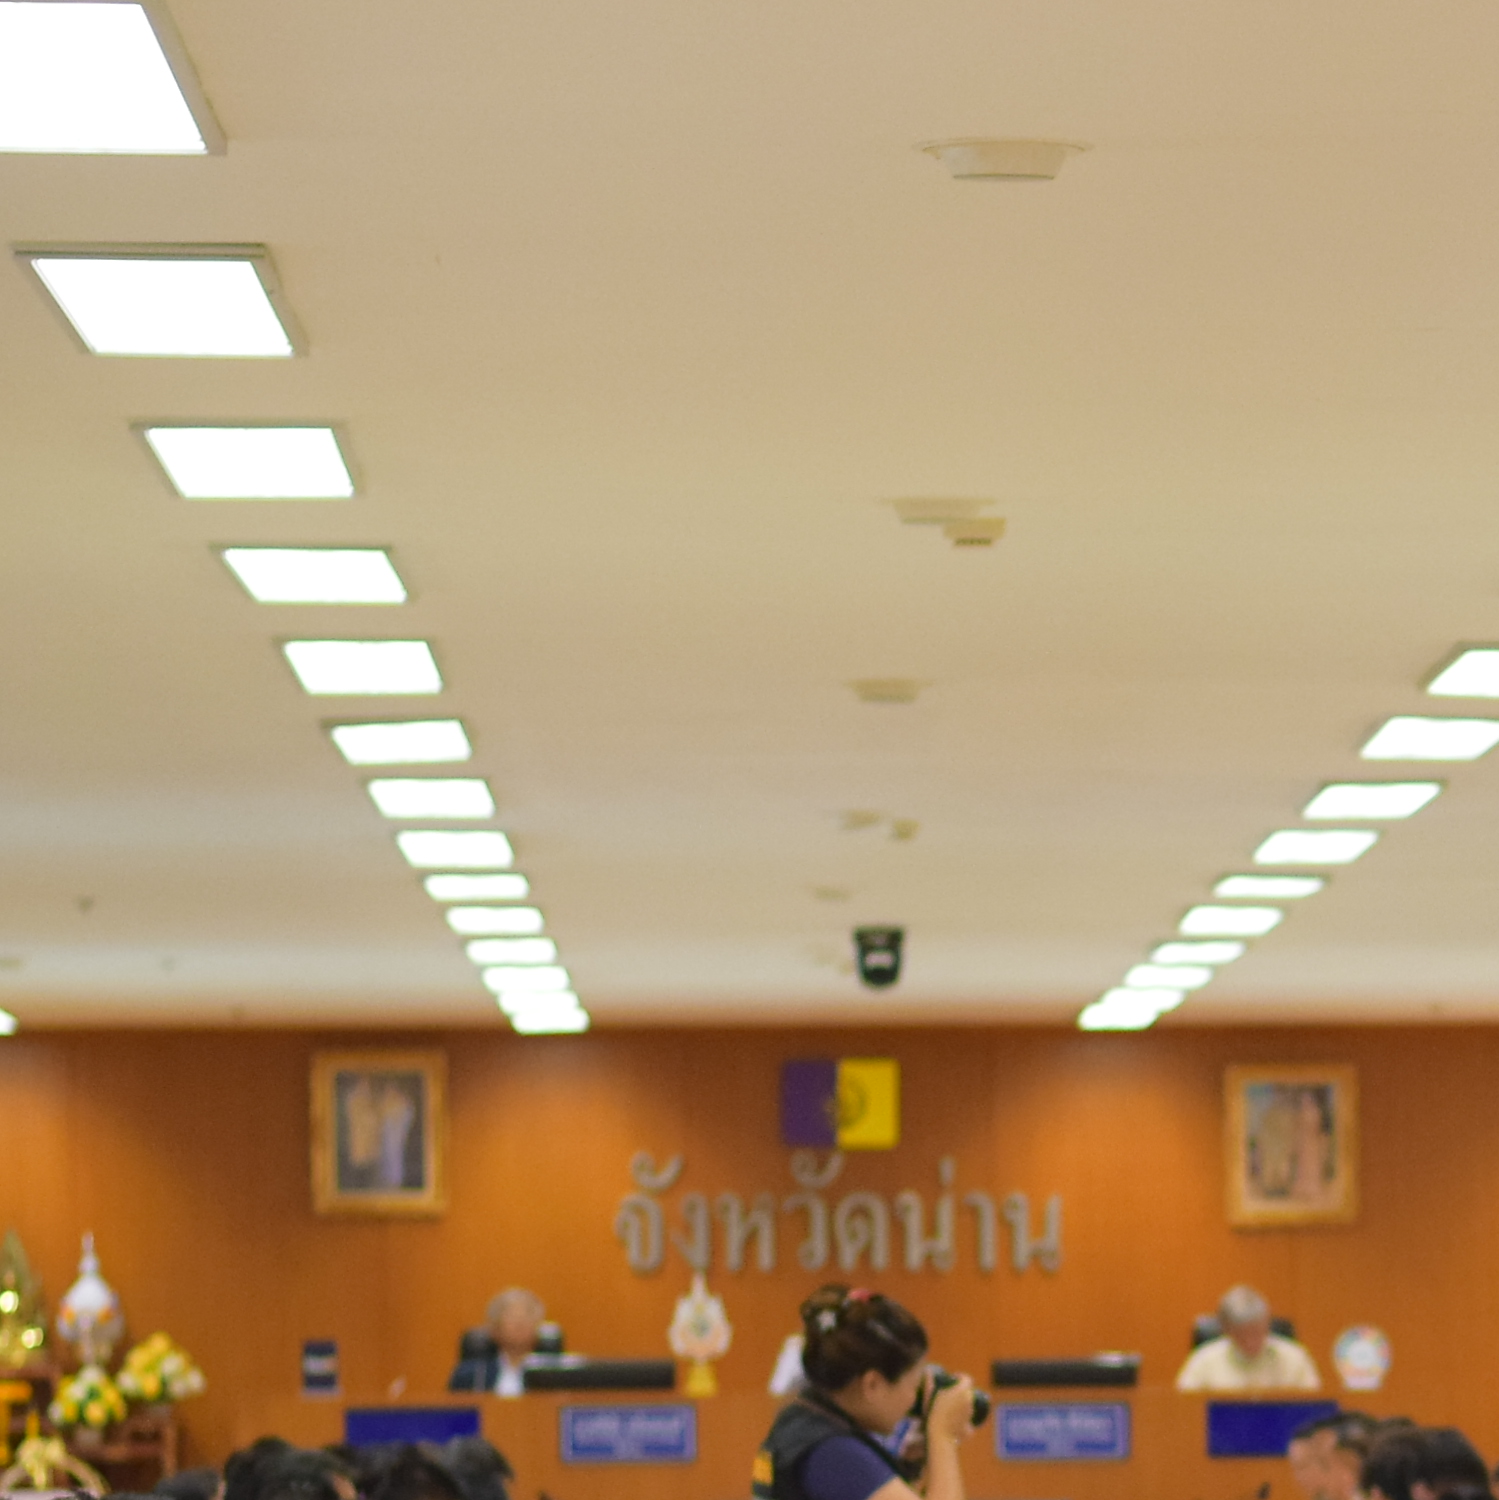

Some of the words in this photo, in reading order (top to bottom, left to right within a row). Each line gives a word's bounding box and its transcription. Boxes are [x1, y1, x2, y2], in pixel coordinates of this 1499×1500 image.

[614, 1150, 1063, 1274] จังหวัดน่าน
